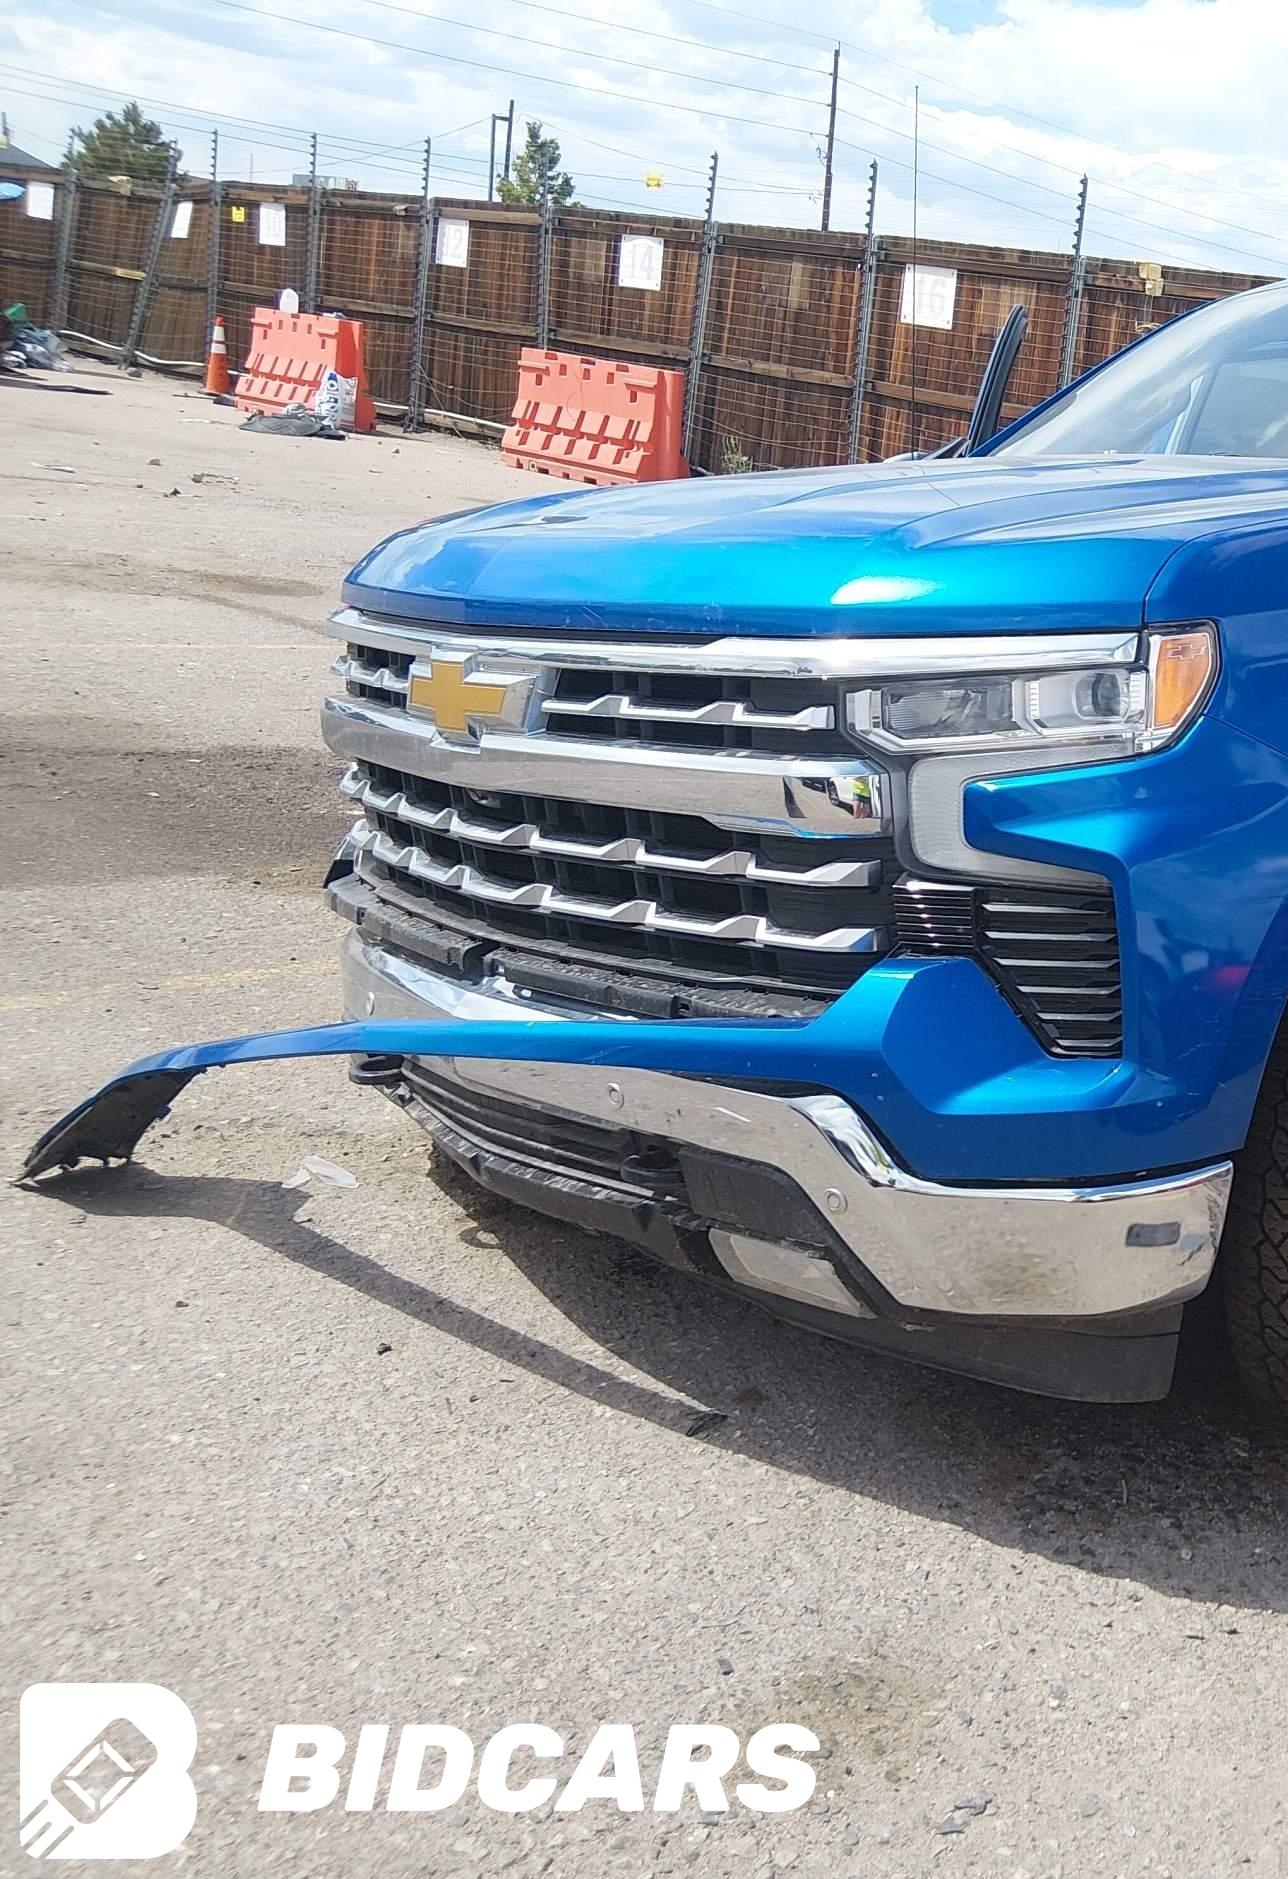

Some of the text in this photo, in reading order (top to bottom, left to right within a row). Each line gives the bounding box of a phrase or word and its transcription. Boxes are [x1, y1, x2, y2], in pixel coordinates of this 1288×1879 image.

[445, 226, 464, 259] 12
[629, 243, 654, 280] 14
[916, 275, 947, 317] 16
